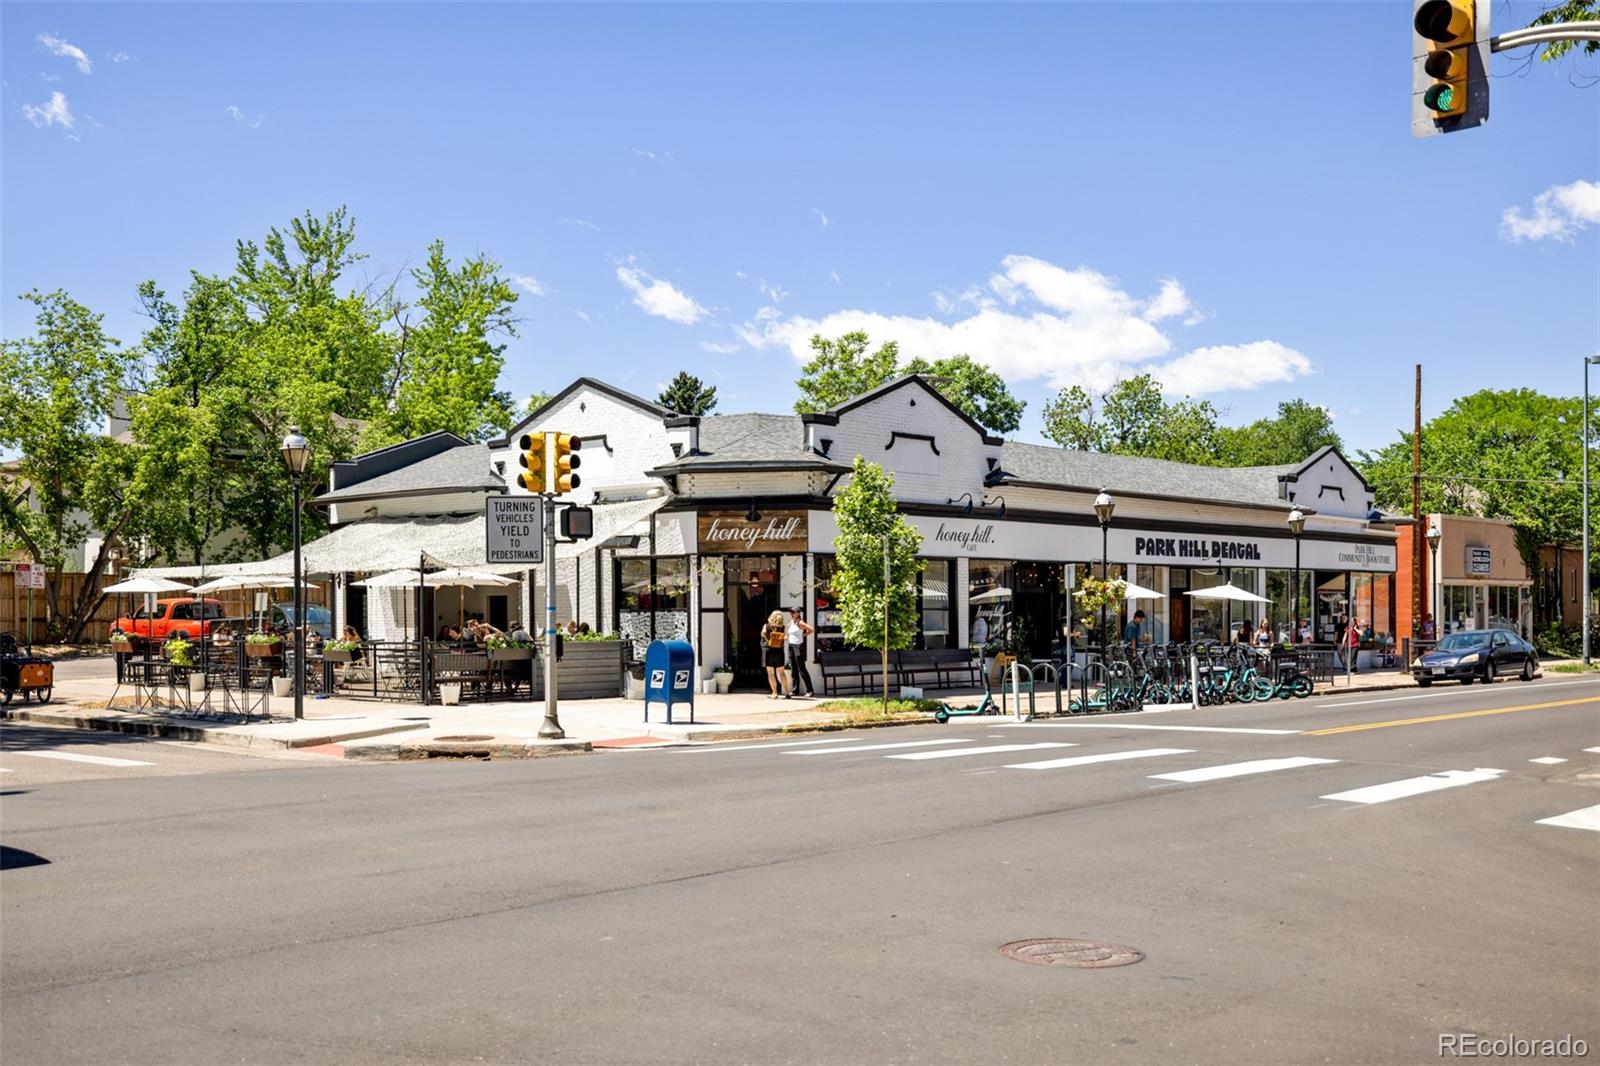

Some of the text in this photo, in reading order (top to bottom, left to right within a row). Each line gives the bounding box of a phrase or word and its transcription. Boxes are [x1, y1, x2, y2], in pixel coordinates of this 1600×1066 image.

[494, 501, 536, 512] TURNING
[495, 513, 534, 523] VEHICLES
[500, 525, 530, 537] YIELD
[706, 517, 801, 549] honey hill
[935, 522, 970, 549] honey
[510, 538, 521, 548] TO
[1135, 537, 1261, 561] PARK HILL DENTAL
[491, 550, 539, 560] PEDESTRIANS
[1338, 552, 1365, 563] COMMUNITY
[1365, 554, 1391, 565] BOOKSTORE
